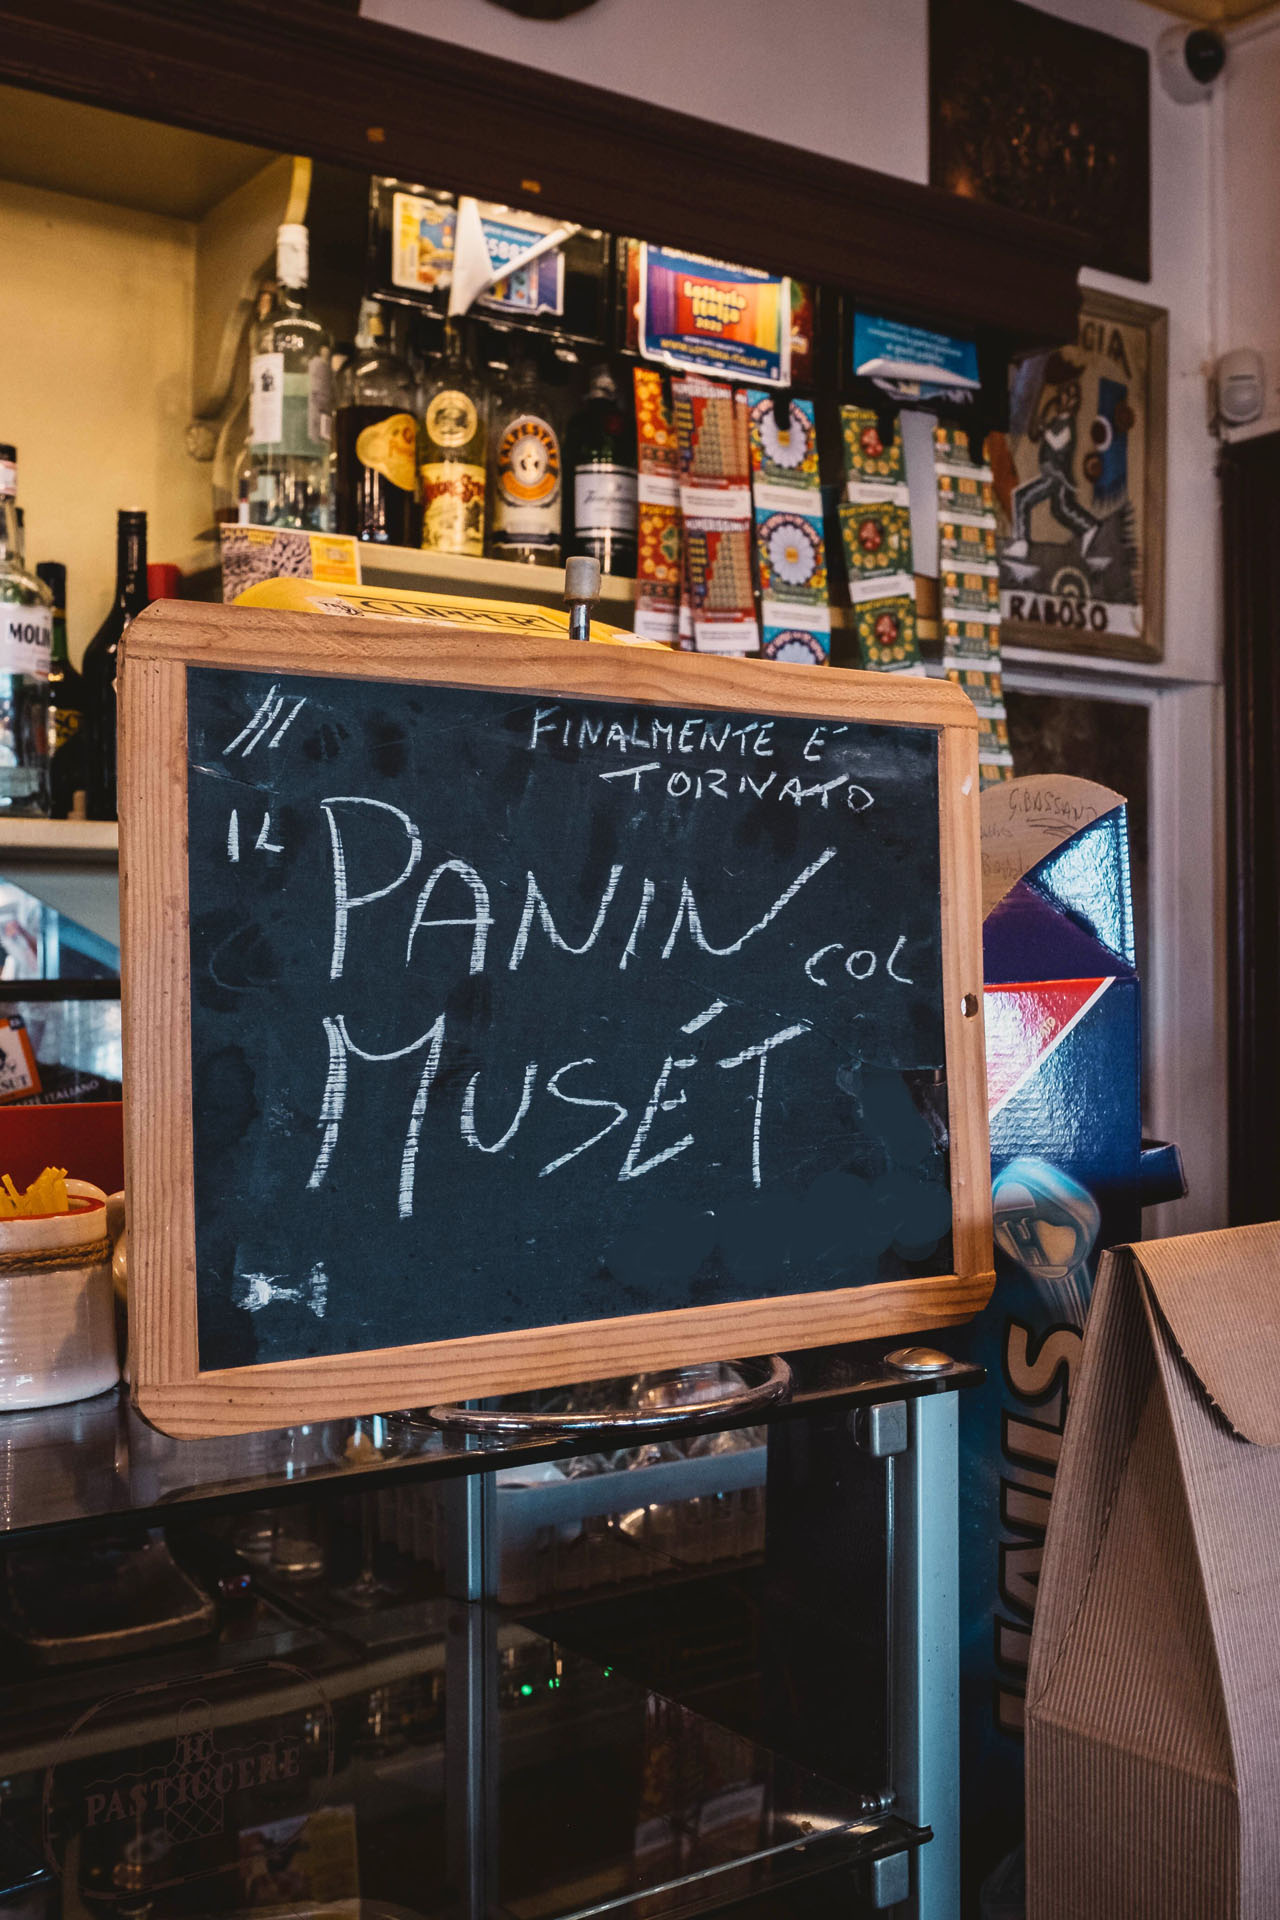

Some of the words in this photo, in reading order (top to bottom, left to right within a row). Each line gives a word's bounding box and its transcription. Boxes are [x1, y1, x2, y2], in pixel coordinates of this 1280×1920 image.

[499, 421, 559, 465] ALPESTRE
[360, 600, 546, 629] CLIPPER
[1009, 595, 1109, 633] RABOSO
[528, 706, 775, 758] FINALMENTE
[599, 762, 875, 811] TORNATO
[228, 808, 285, 863] IL
[320, 796, 838, 981] PANIN
[804, 935, 914, 987] COL
[305, 998, 812, 1219] MUSÉT
[84, 1744, 303, 1829] PASTICCERE
